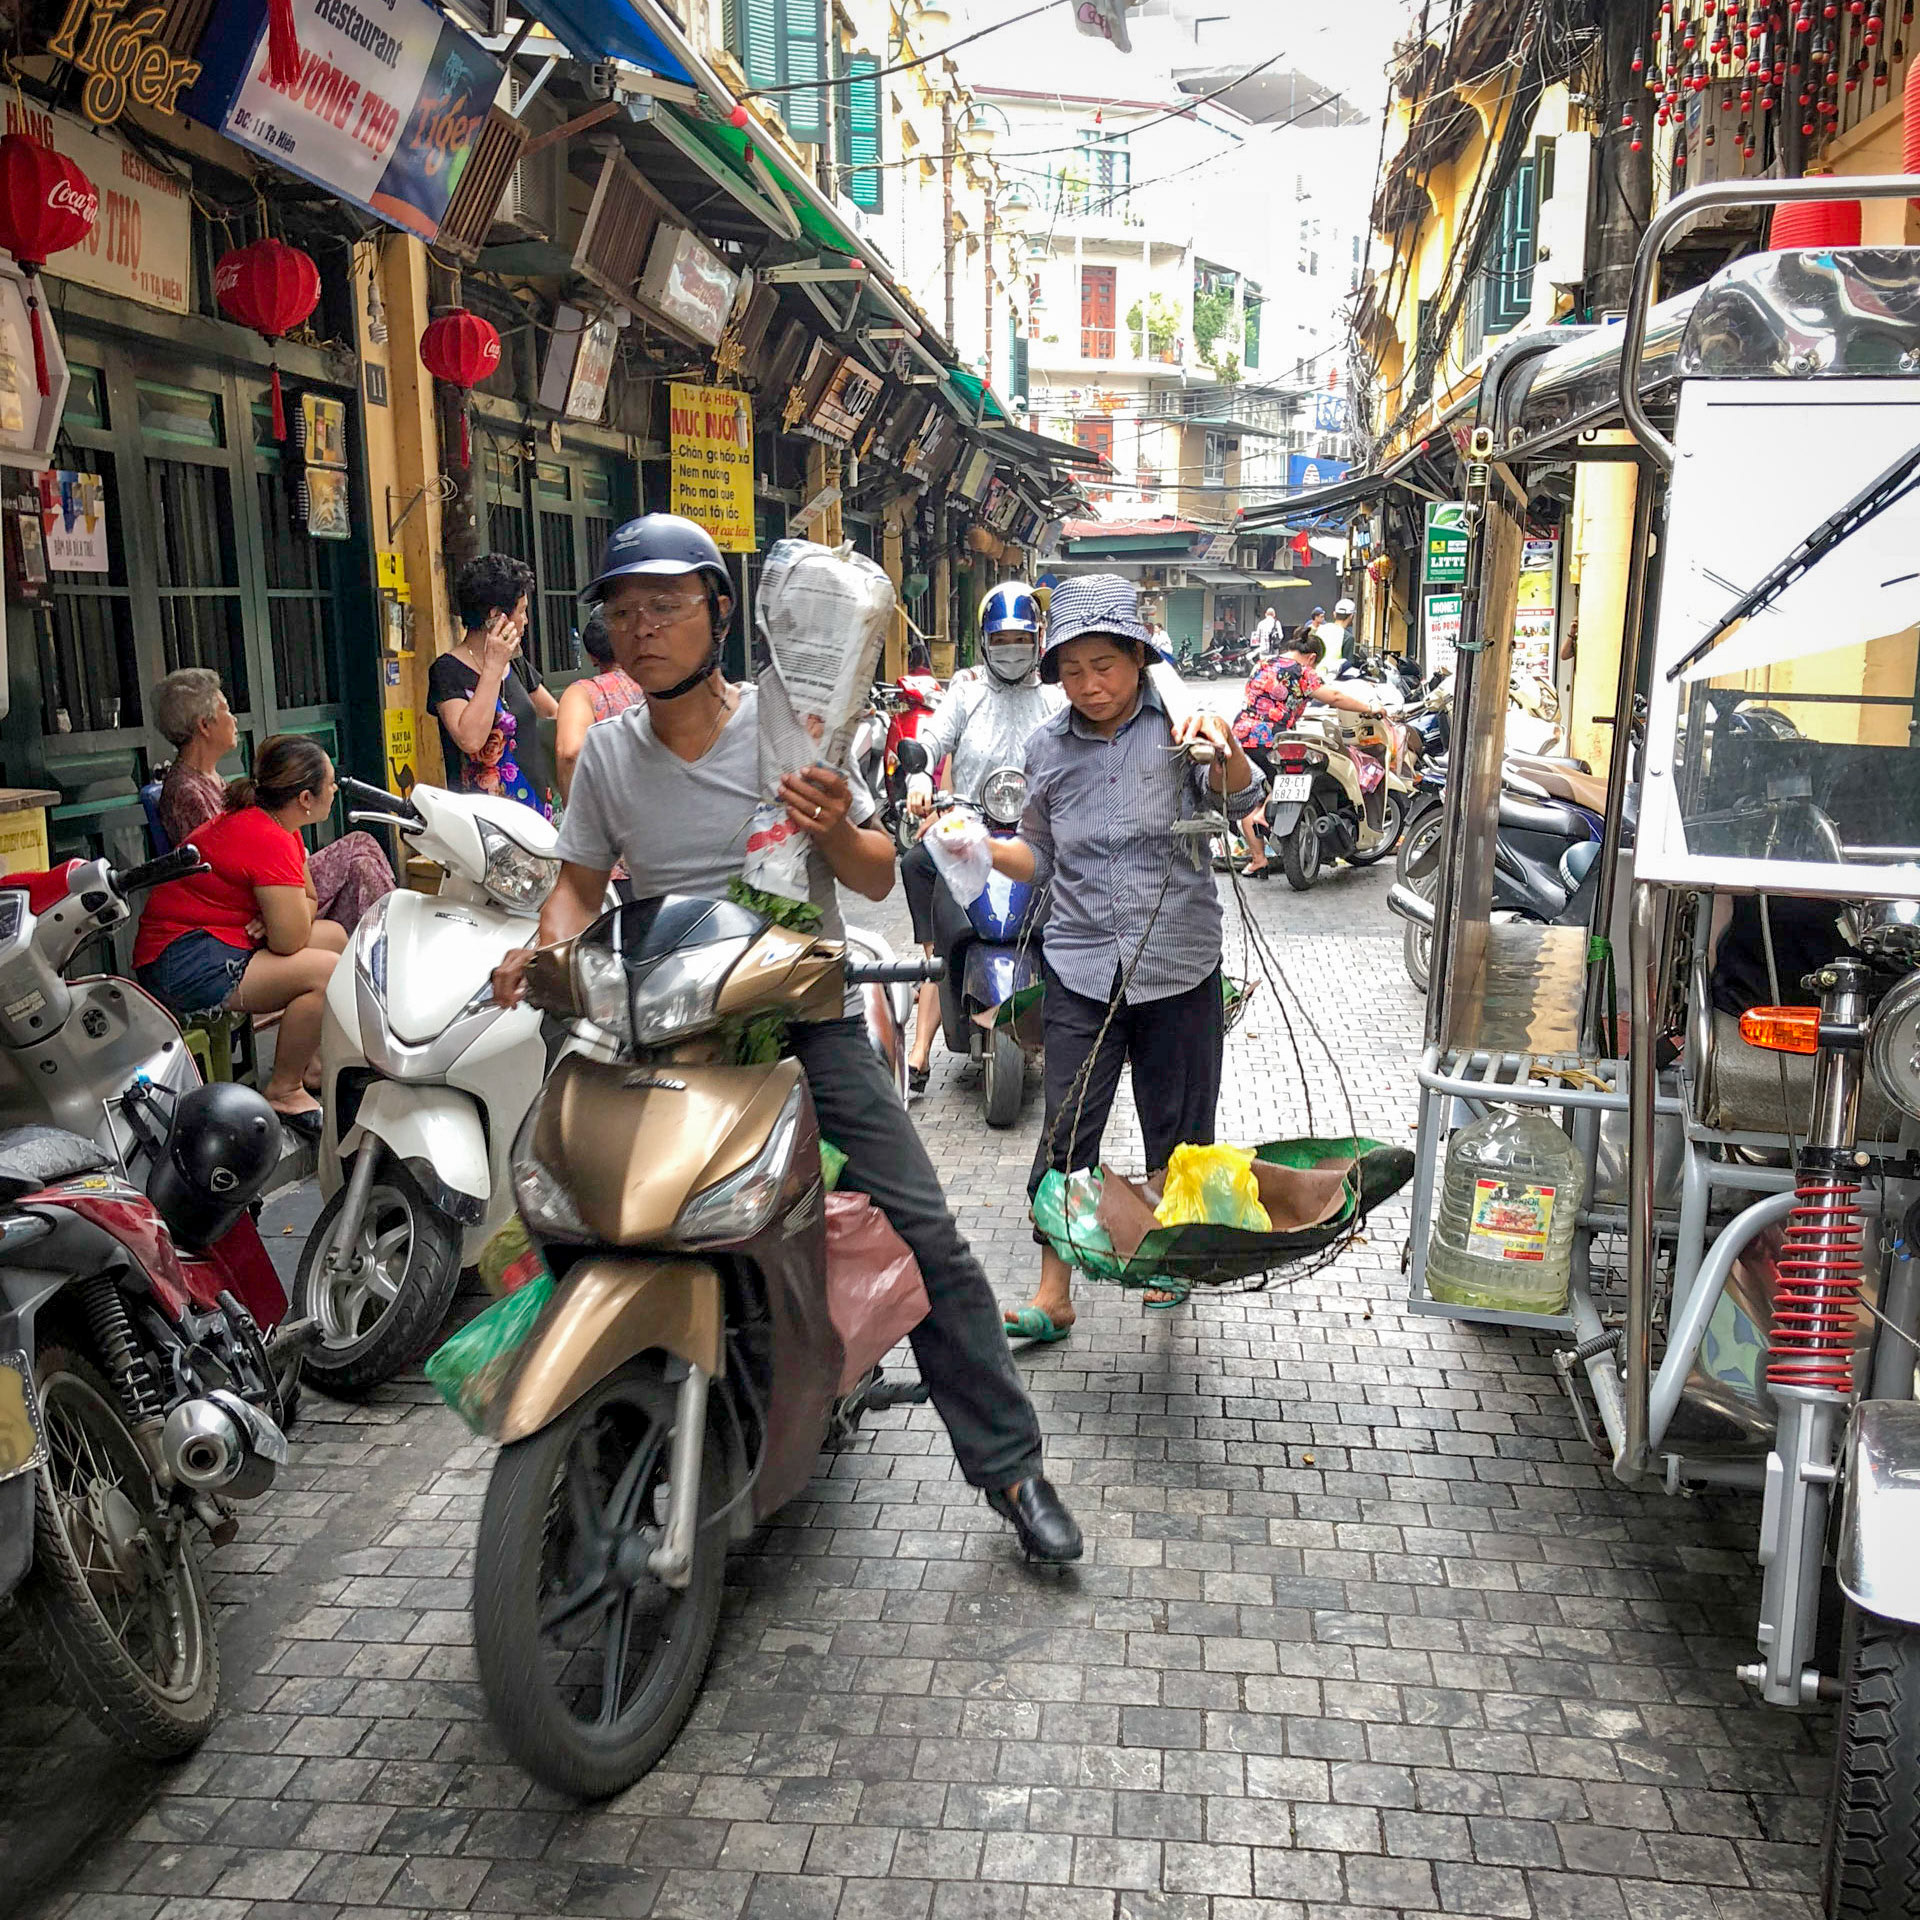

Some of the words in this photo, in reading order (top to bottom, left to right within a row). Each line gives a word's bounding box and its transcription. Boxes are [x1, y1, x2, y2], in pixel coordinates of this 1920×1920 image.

[314, 0, 404, 69] Restaurant
[409, 91, 484, 177] Tiger
[679, 463, 703, 478] Nem
[699, 484, 719, 500] mai
[680, 503, 707, 518] Khoai
[1432, 602, 1458, 613] MONEY
